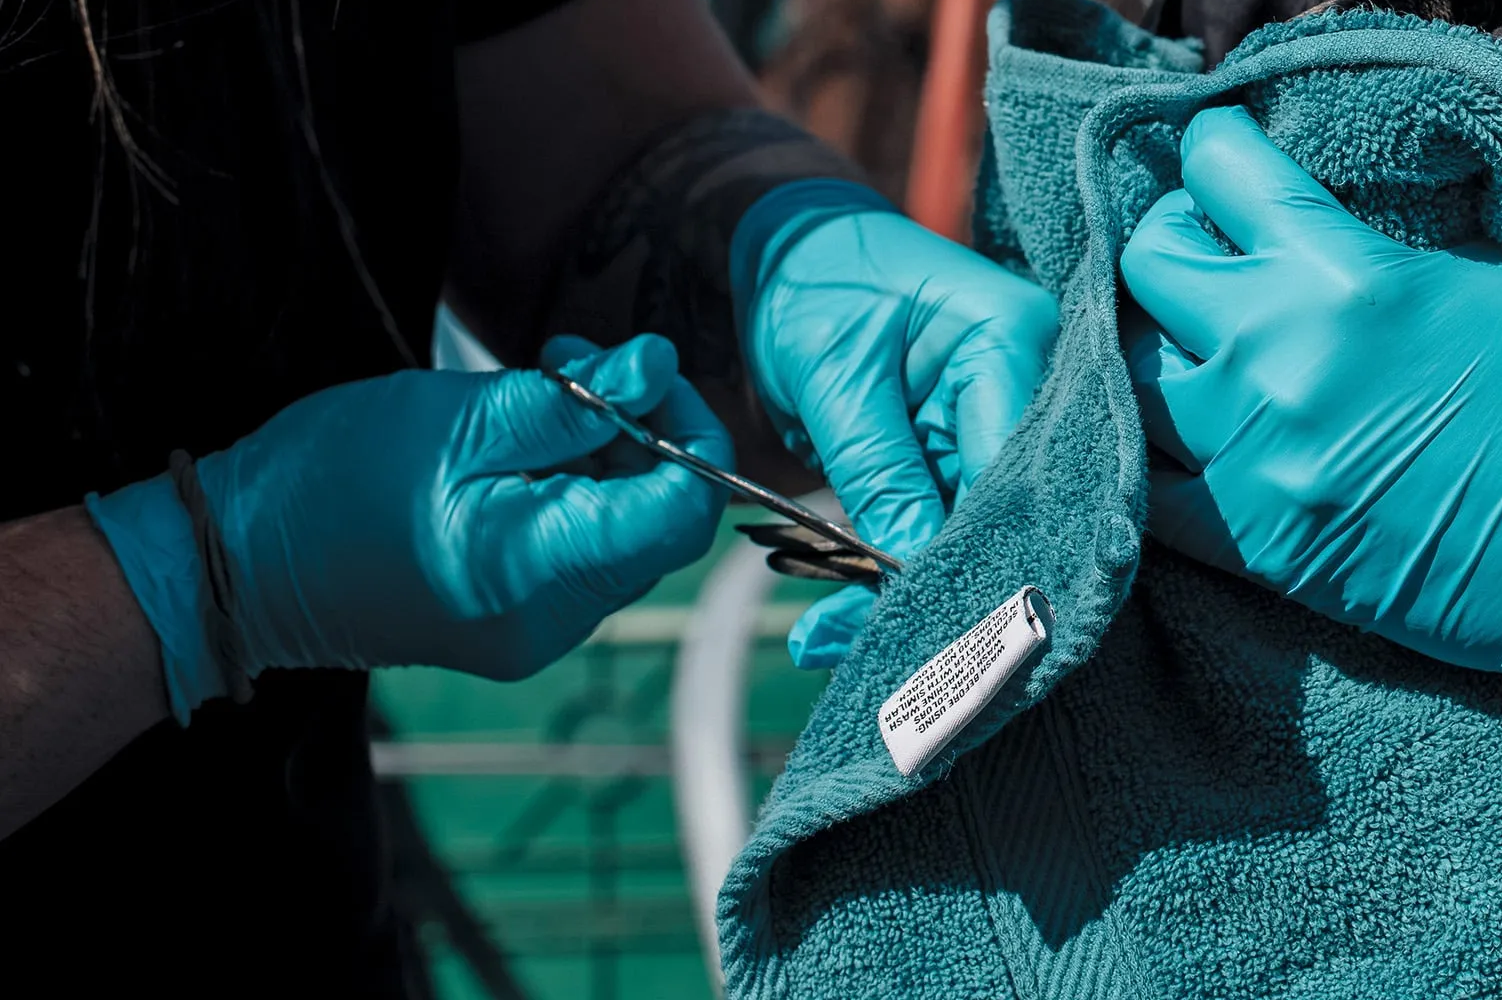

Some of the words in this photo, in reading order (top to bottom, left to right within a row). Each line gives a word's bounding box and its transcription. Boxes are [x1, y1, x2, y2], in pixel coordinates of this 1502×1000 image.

[1009, 600, 1019, 613] IN
[953, 635, 986, 669] WATER
[957, 639, 971, 654] DO
[977, 639, 1001, 668] WASH
[980, 645, 1005, 675] WASH
[911, 664, 934, 685] LOW
[938, 651, 958, 673] NOT
[921, 667, 964, 707] MACHINE
[926, 667, 953, 692] WITH
[948, 673, 979, 707] BEFORE
[951, 666, 975, 693] DARK
[884, 688, 926, 723] SIMILAR
[889, 705, 920, 731] WASH
[914, 692, 949, 724] COLORS
[915, 705, 946, 733] USING.
